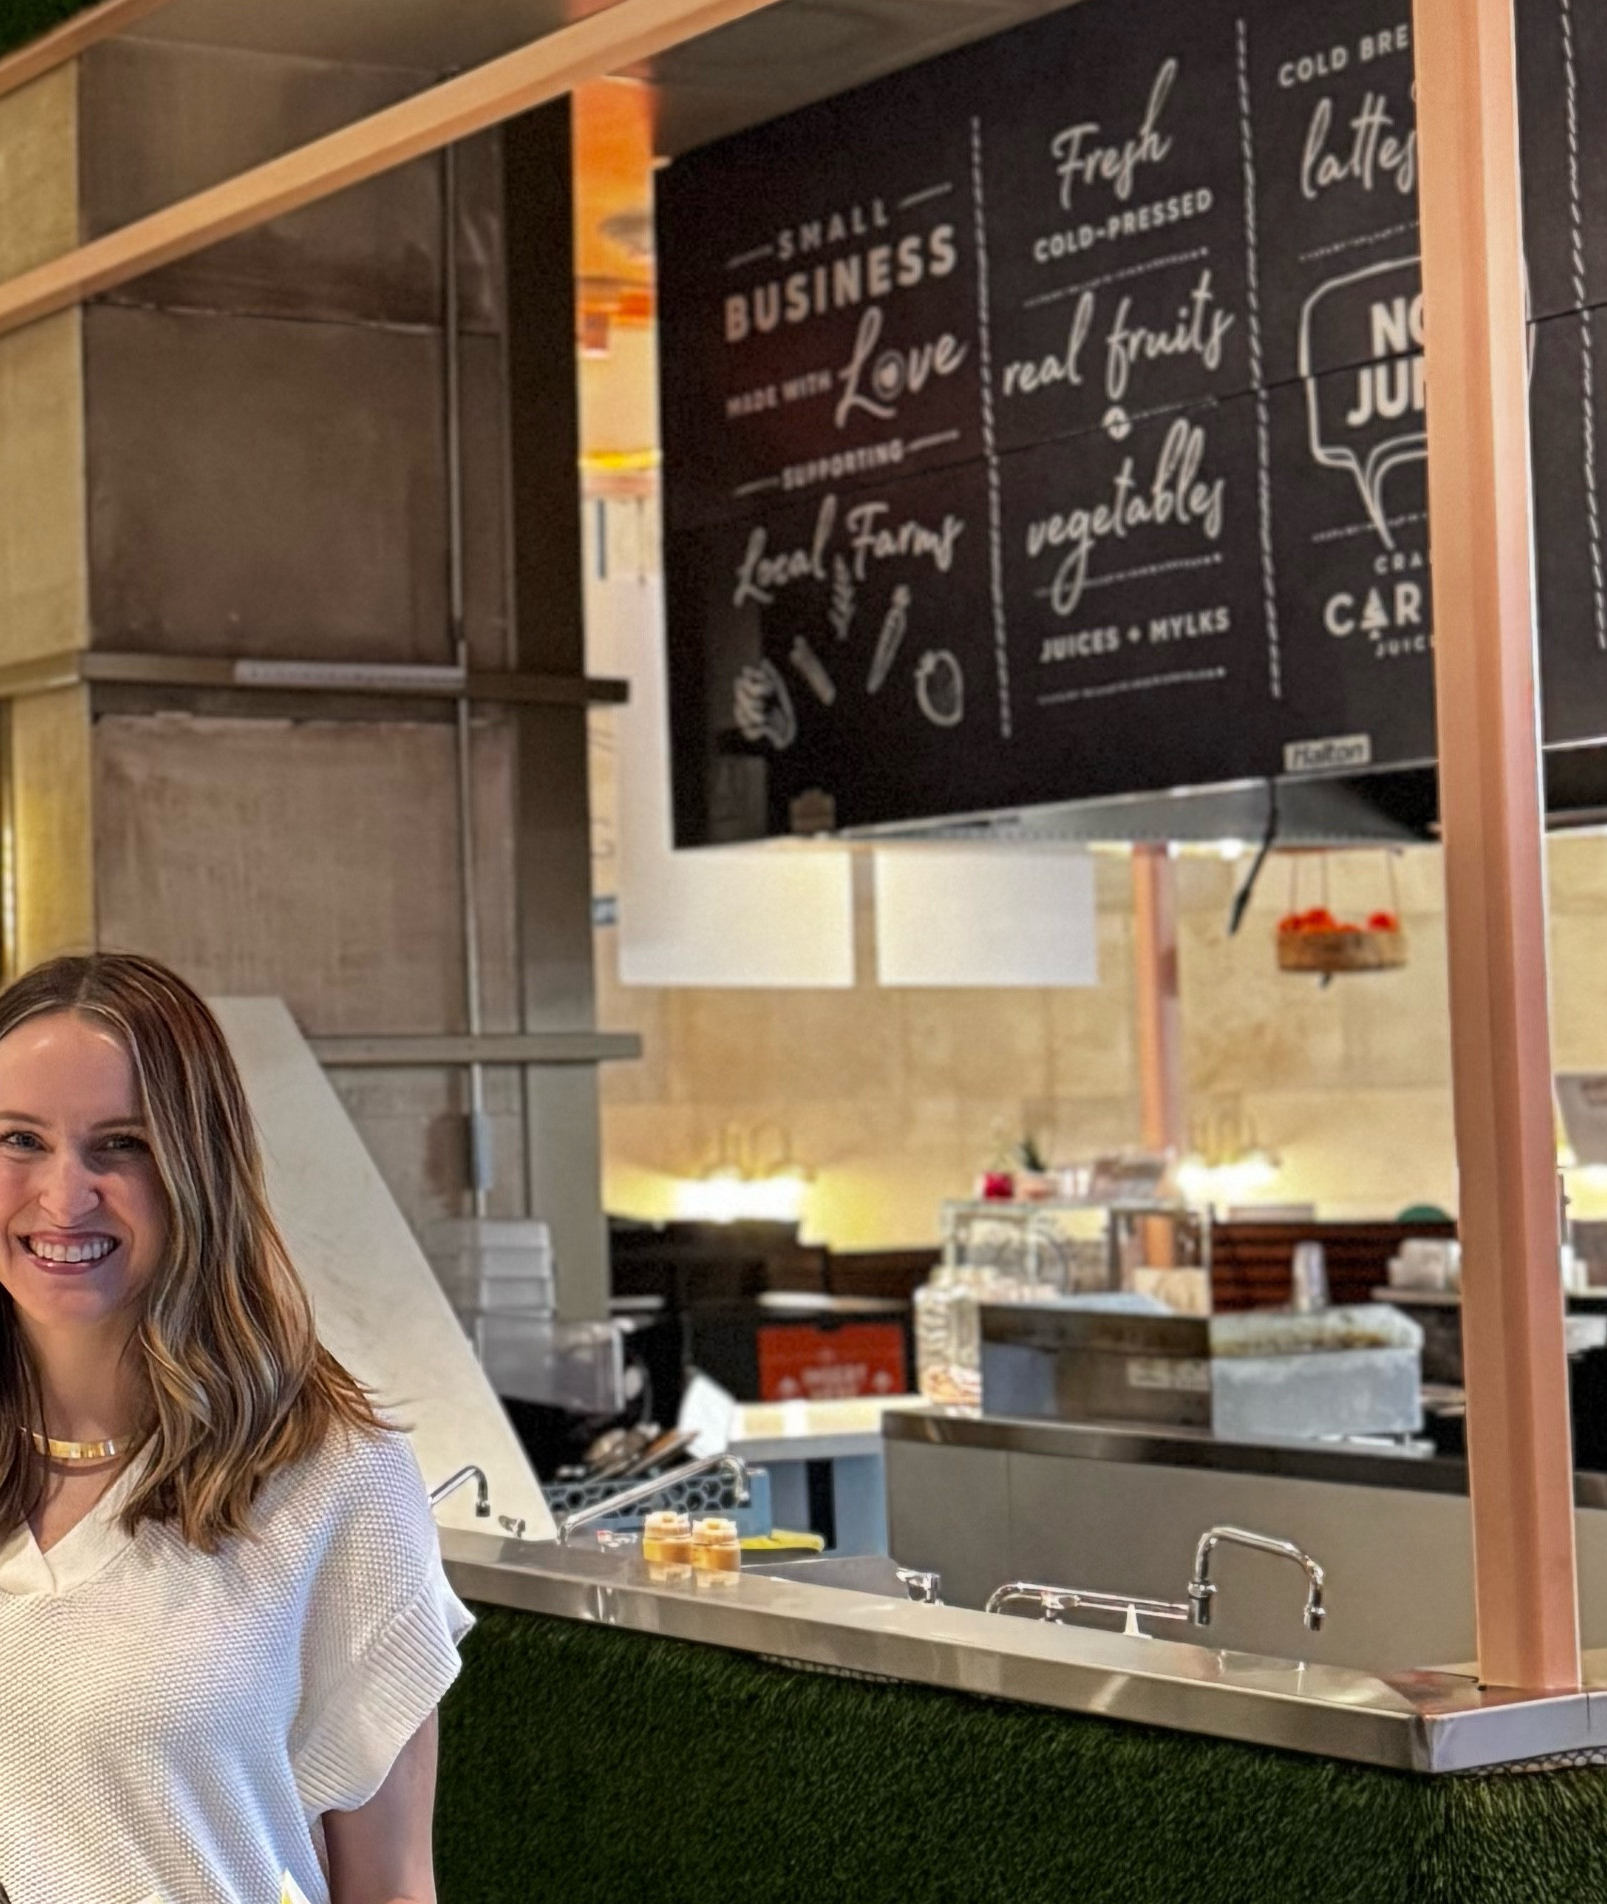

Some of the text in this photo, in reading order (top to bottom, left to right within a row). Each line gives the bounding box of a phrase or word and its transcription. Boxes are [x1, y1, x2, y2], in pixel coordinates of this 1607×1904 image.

[1277, 46, 1350, 88] COLD
[1050, 57, 1179, 212] Fresh
[776, 197, 891, 263] SMALL
[1033, 187, 1215, 264] COLD-PRESSED
[724, 222, 959, 344] BUSINESS
[1001, 267, 1237, 402] real fruits
[781, 368, 832, 403] WITH
[782, 437, 905, 492] SUPPORTING
[733, 493, 966, 607] Local Farms
[1025, 417, 1225, 617] vegetables
[1040, 625, 1121, 665] JUICES
[1149, 605, 1231, 645] MYLKS
[1294, 743, 1365, 768] Halton
